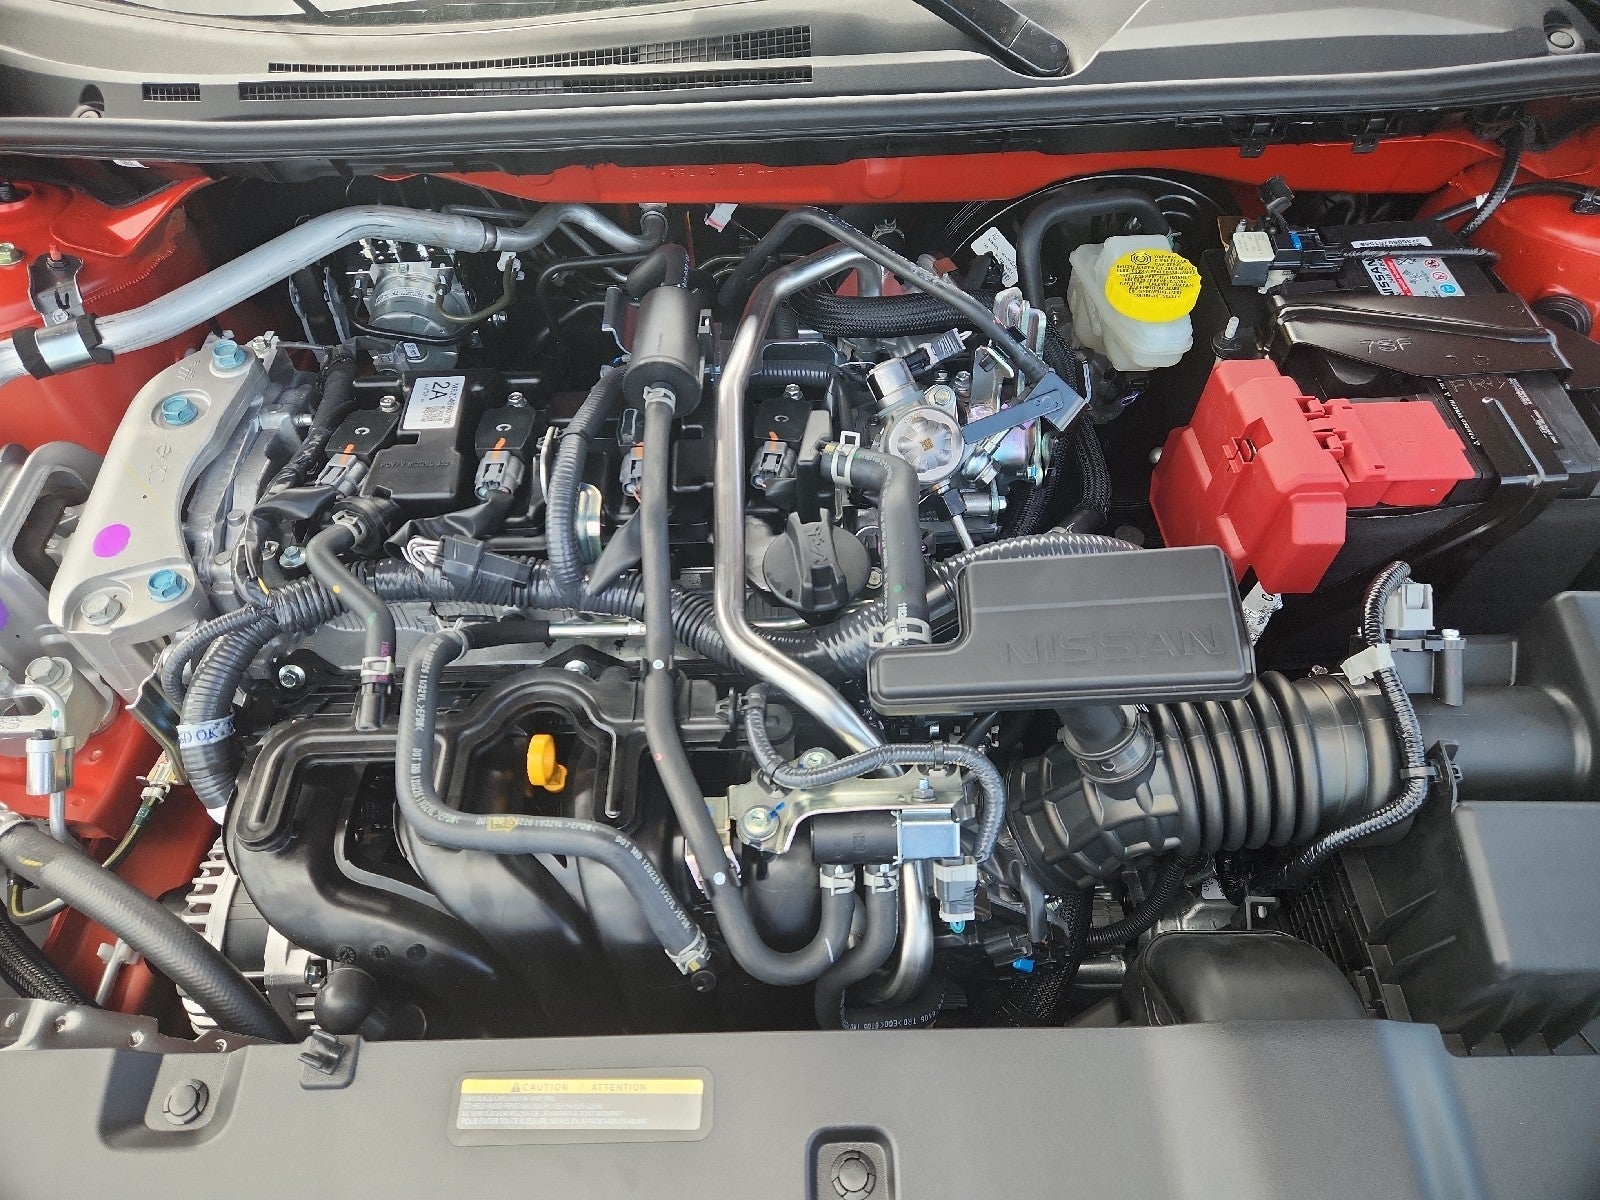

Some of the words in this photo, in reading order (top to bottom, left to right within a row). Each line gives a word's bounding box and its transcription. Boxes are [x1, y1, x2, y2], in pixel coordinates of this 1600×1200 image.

[428, 380, 451, 401] 2A
[1002, 626, 1224, 666] NISSAN
[196, 727, 218, 741] OK
[522, 1083, 569, 1092] CAUTION
[591, 1083, 647, 1092] ATTENTION
